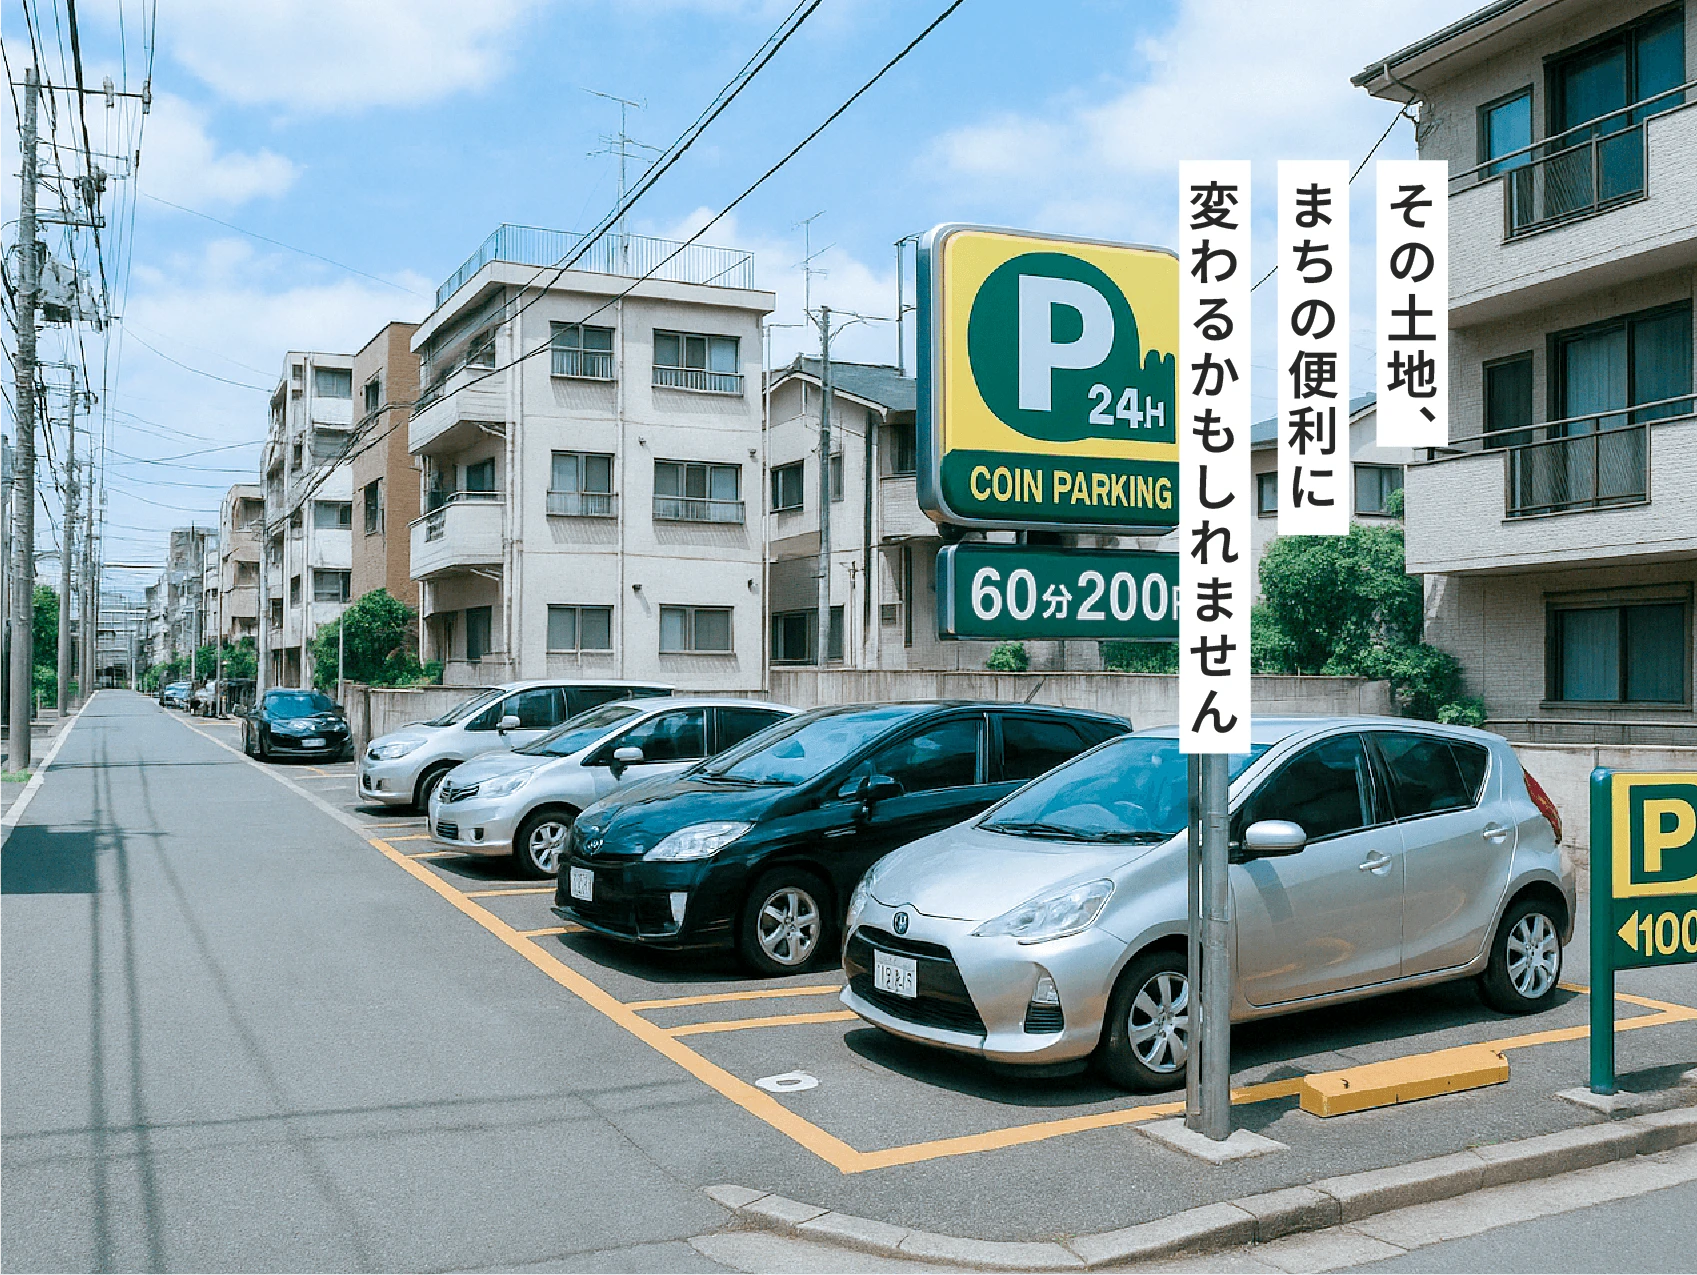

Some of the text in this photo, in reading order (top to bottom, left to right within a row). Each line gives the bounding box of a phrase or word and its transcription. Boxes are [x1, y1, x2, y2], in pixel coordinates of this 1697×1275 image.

[1018, 273, 1115, 411] P
[1087, 384, 1165, 428] 24H
[970, 465, 1172, 510] COIN PARKING
[971, 566, 1179, 621] 60分200
[1643, 798, 1697, 872] P
